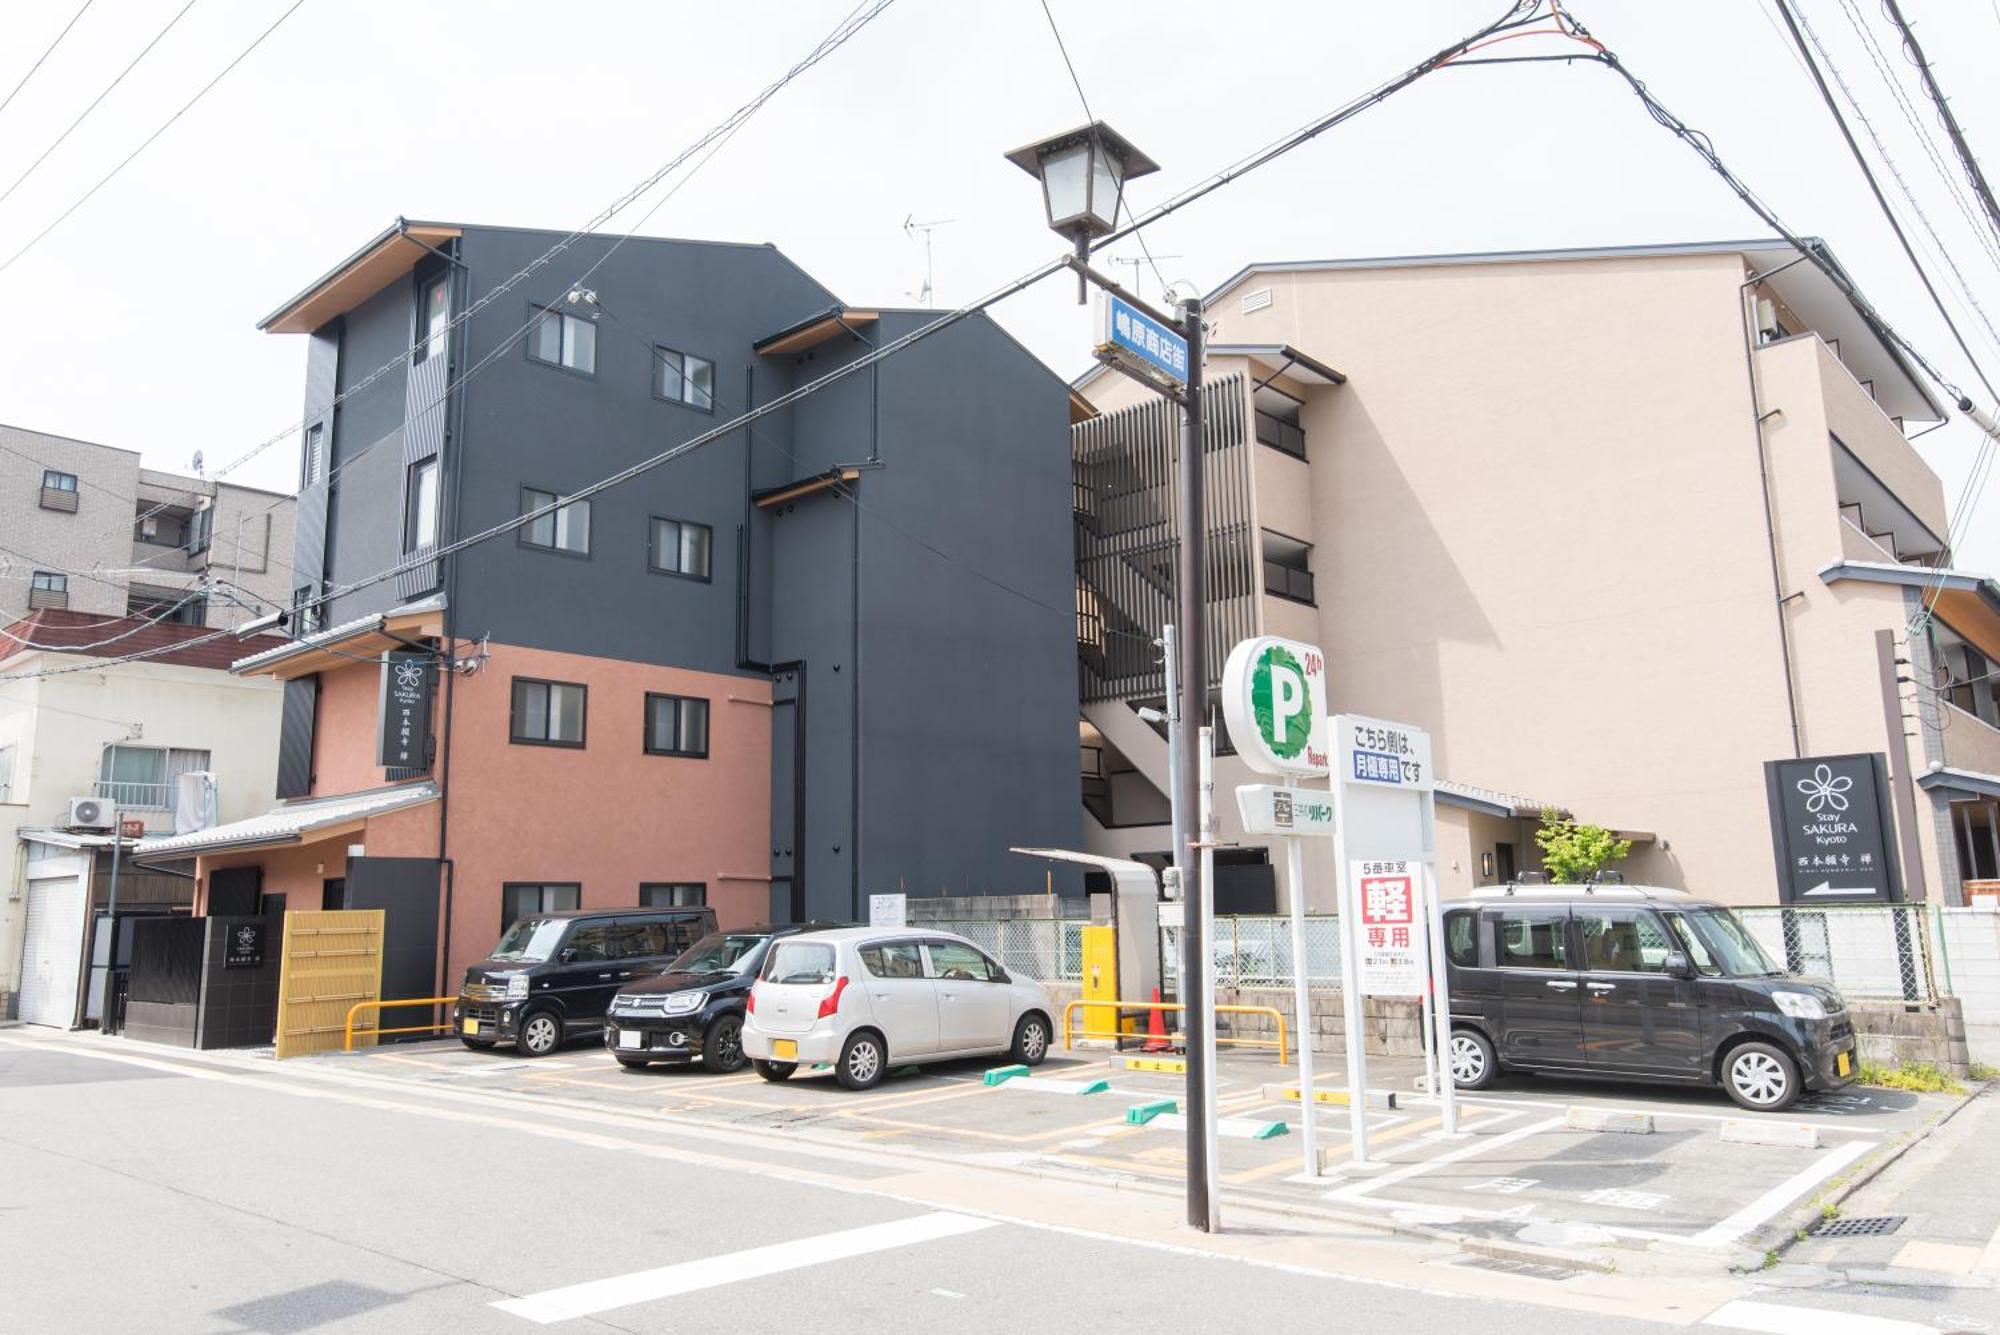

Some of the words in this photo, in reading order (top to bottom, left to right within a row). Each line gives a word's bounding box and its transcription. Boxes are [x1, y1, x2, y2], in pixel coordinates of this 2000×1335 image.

[1270, 664, 1303, 743] P
[1816, 813, 1840, 822] Stay
[1803, 823, 1858, 835] SAKURA
[1816, 835, 1847, 846] Kyoto
[1366, 880, 1408, 923] 軽
[1368, 926, 1410, 948] 専用
